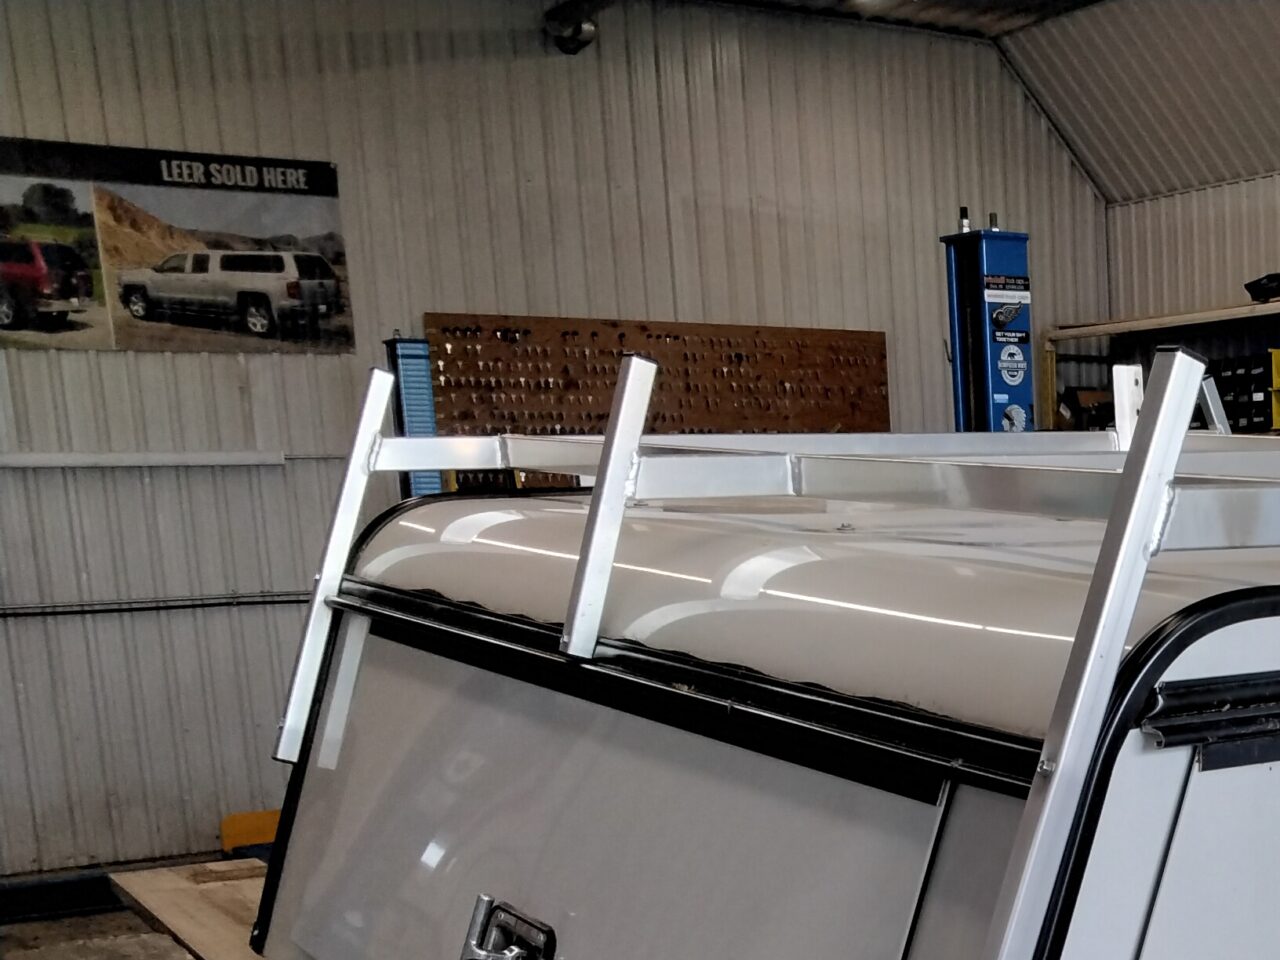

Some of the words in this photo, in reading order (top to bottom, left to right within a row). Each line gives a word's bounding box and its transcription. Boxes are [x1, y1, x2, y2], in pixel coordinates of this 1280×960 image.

[160, 159, 206, 184] LEER
[209, 163, 259, 187] SOLD
[263, 167, 309, 190] HERE
